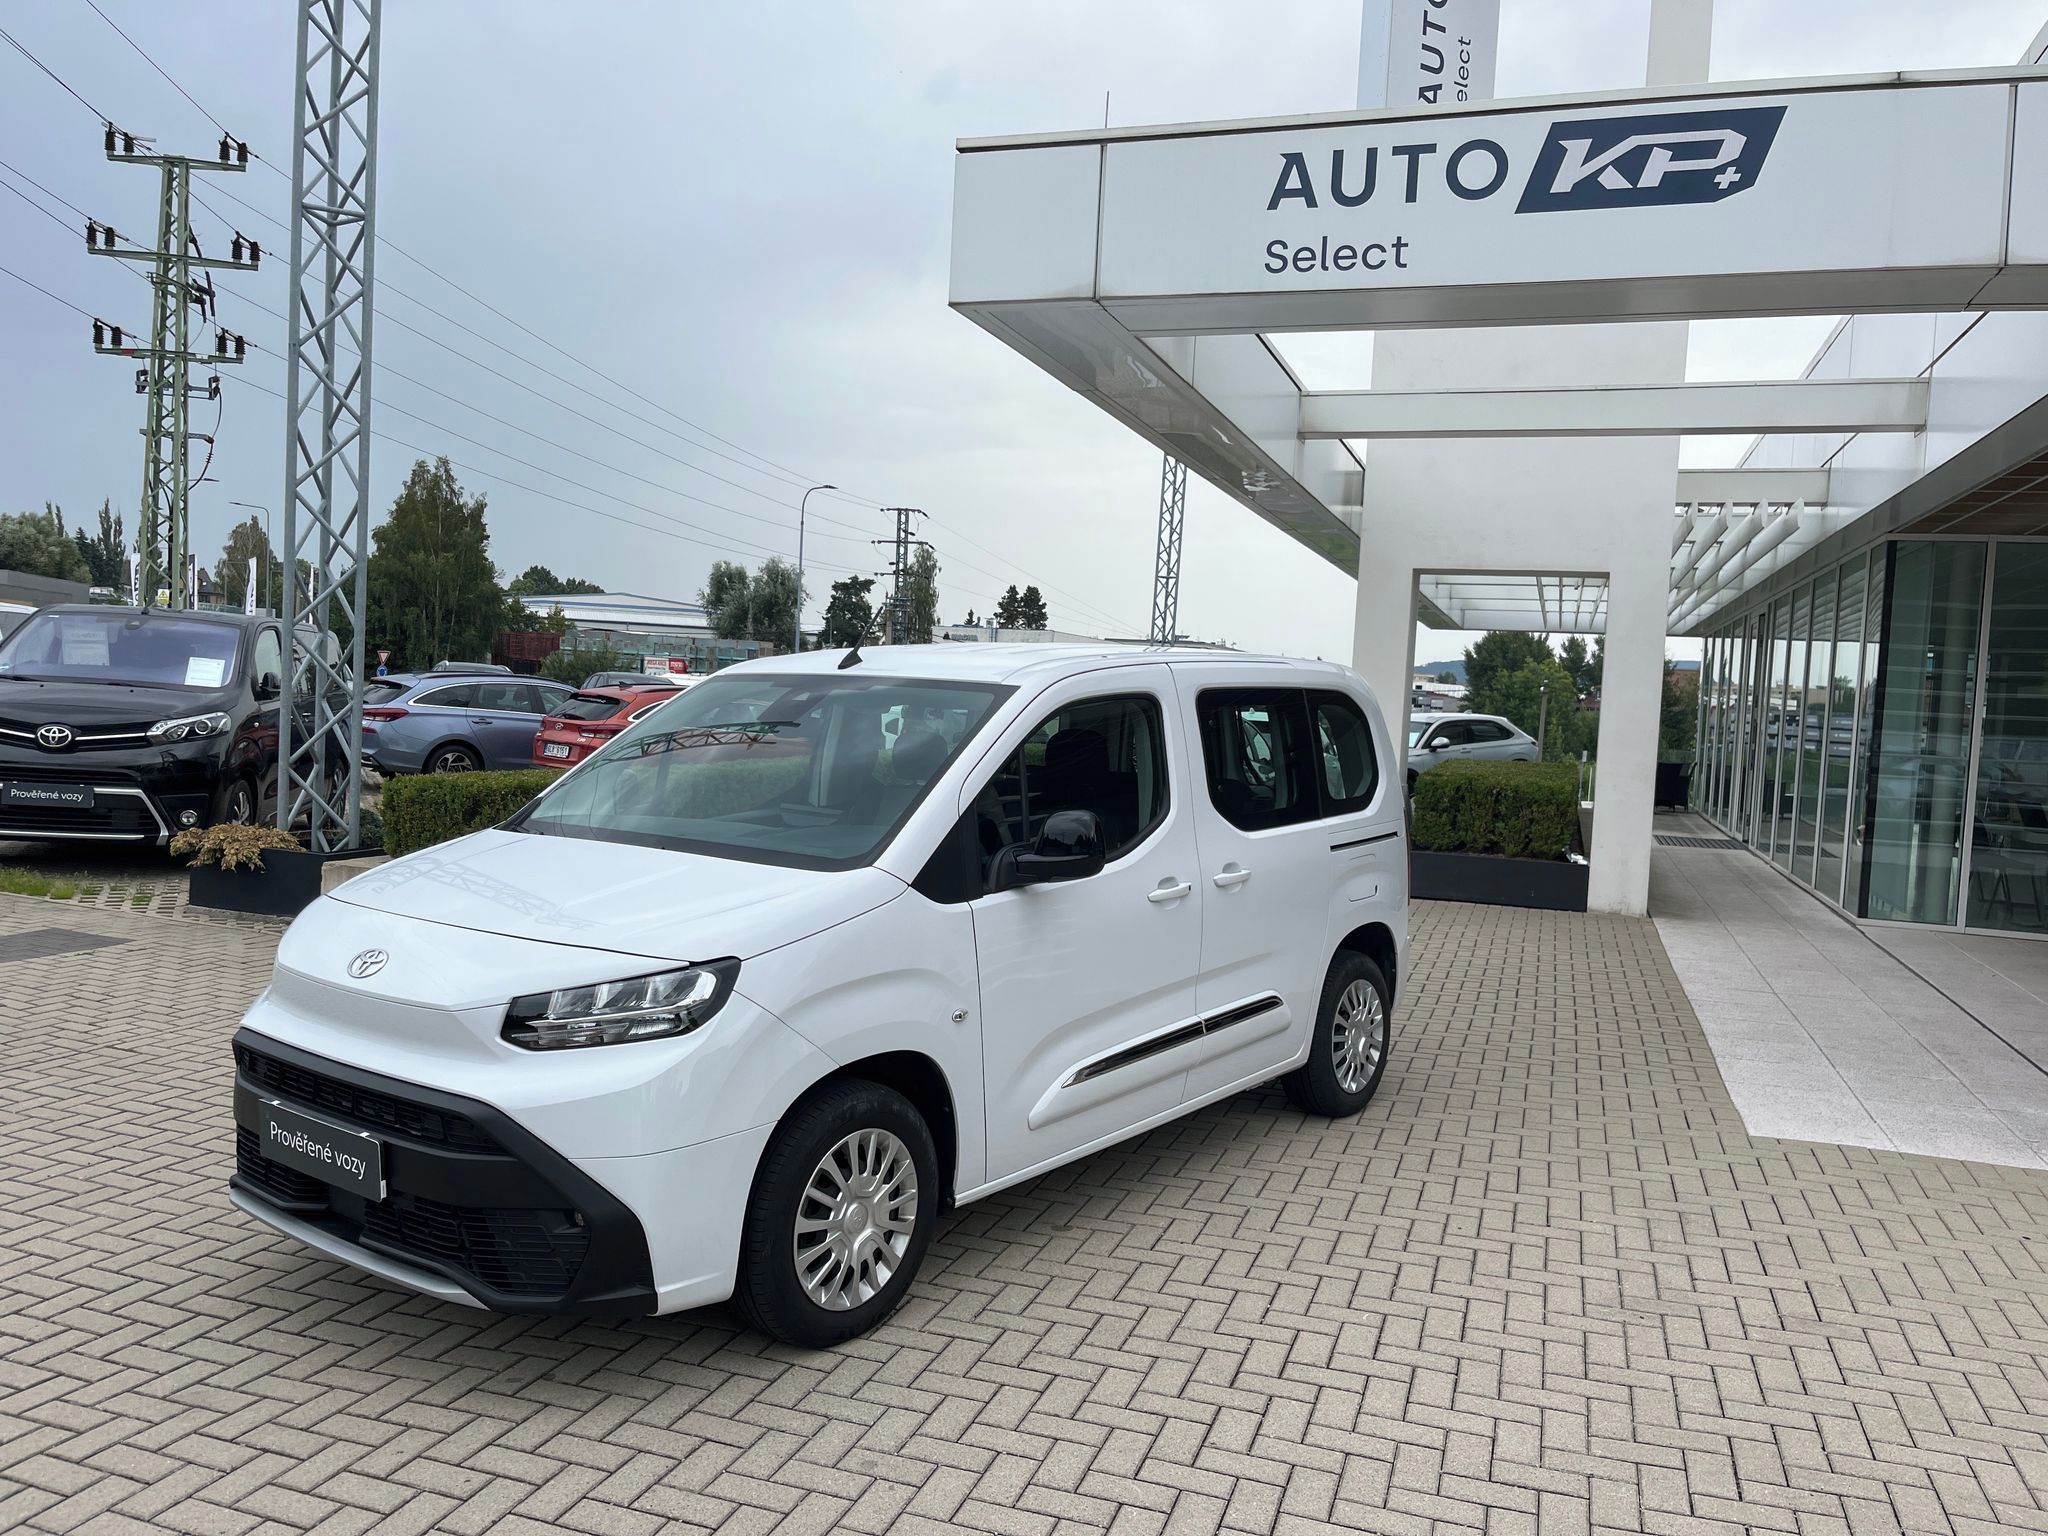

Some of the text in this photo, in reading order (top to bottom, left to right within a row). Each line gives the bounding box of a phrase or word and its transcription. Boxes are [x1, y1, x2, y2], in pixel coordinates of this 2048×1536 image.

[1418, 0, 1447, 104] AUT
[1454, 36, 1471, 101] elect
[1267, 139, 1509, 210] AUTO
[1264, 236, 1409, 274] Select
[11, 788, 84, 802] Prověřené vozy
[270, 1121, 366, 1180] Prověřené vozy
